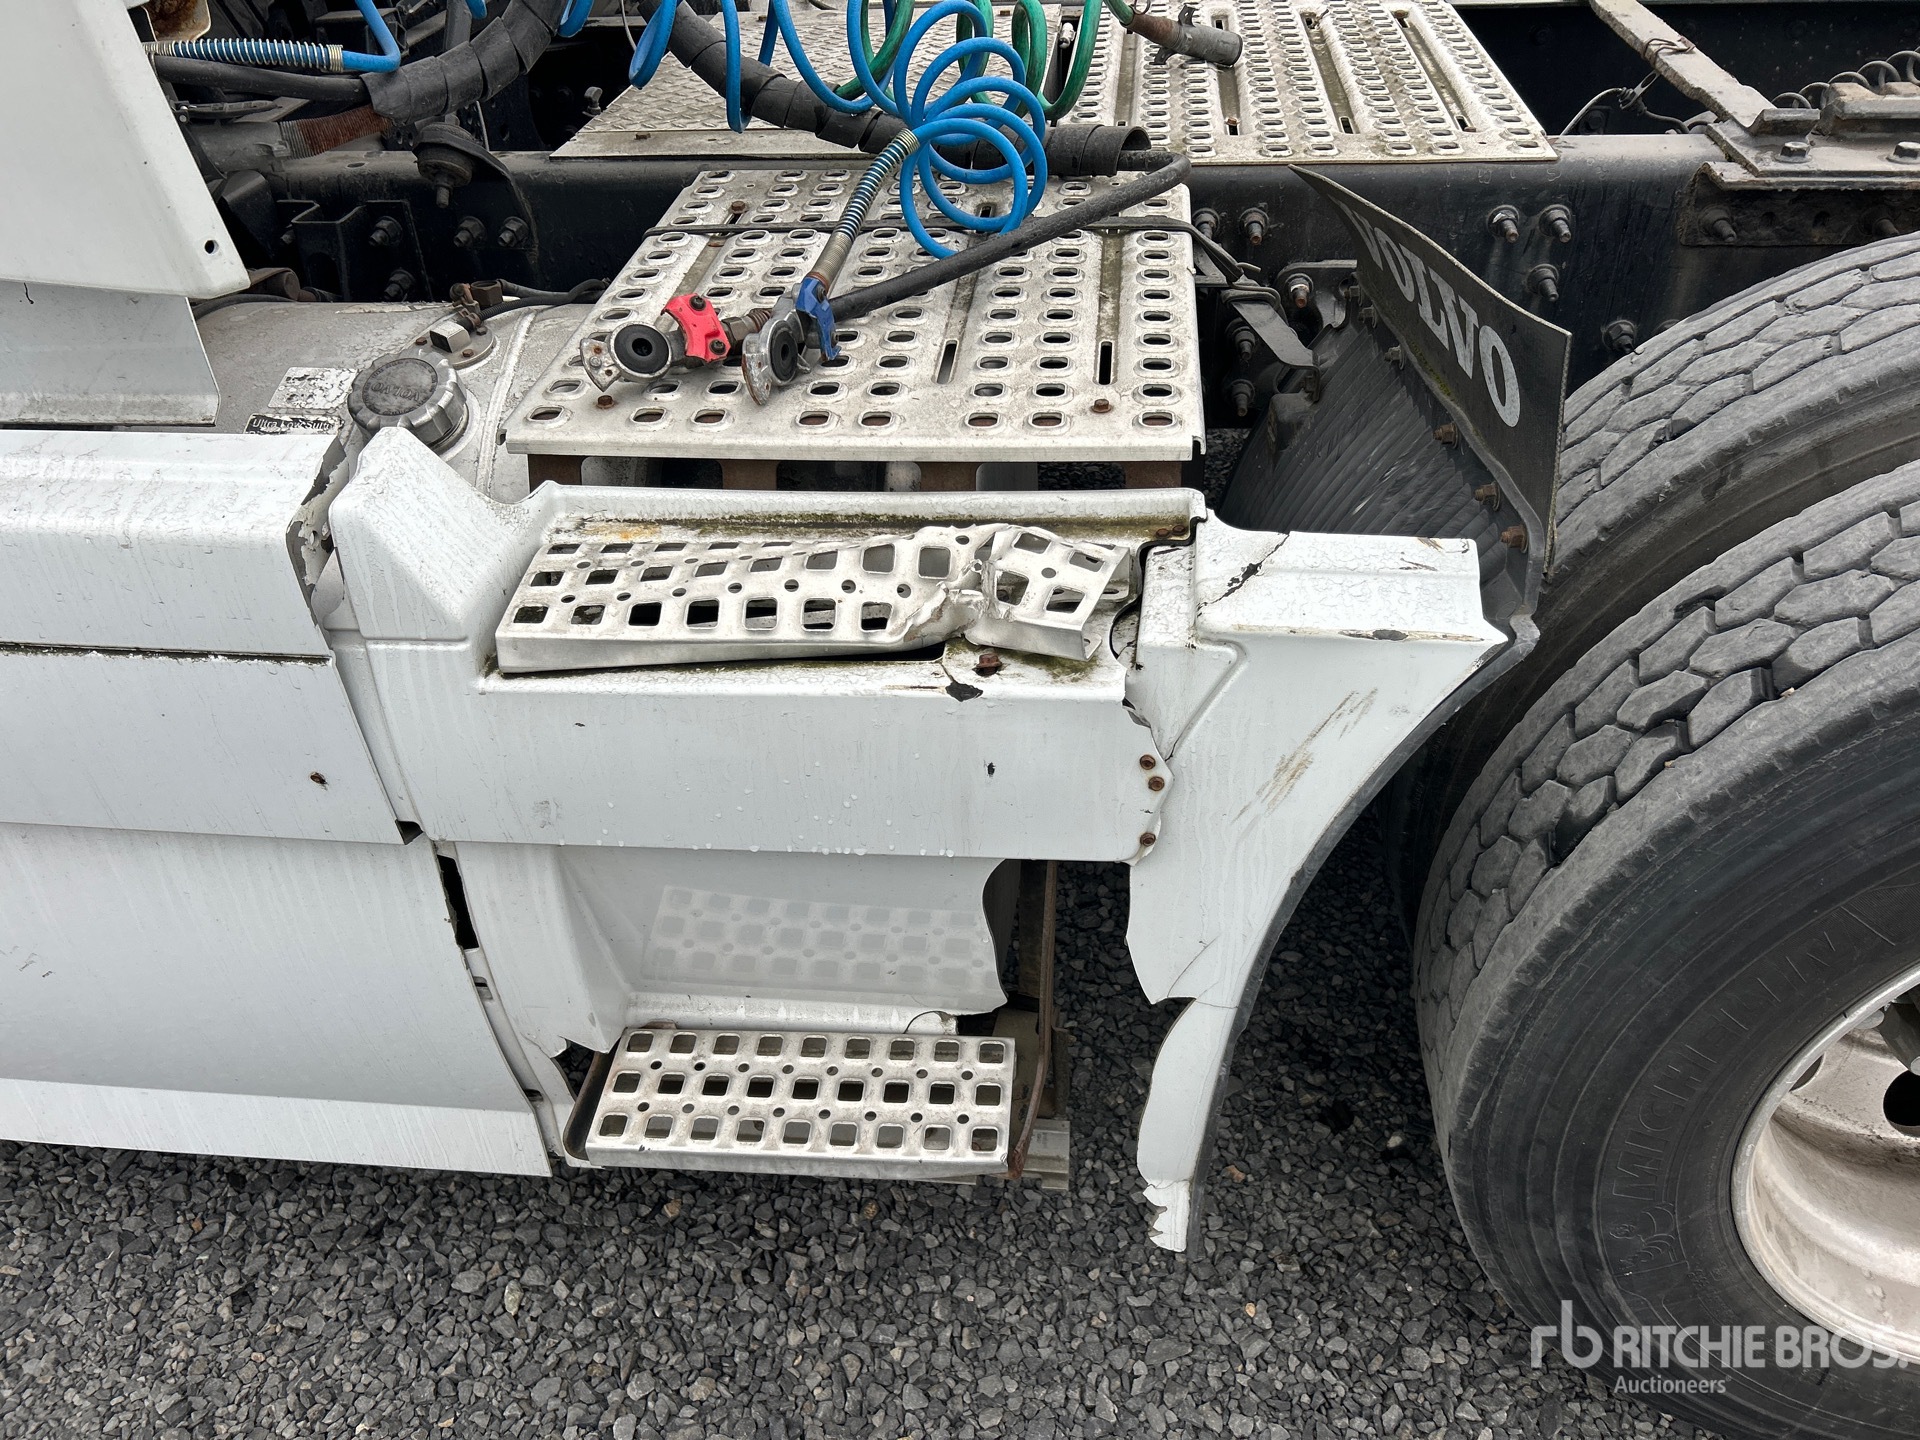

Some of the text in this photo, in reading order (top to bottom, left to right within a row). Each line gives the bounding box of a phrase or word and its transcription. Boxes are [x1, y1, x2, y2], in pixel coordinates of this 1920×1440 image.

[1331, 197, 1520, 428] VOLVO
[371, 383, 419, 402] VOLVO
[253, 418, 278, 429] Ultra
